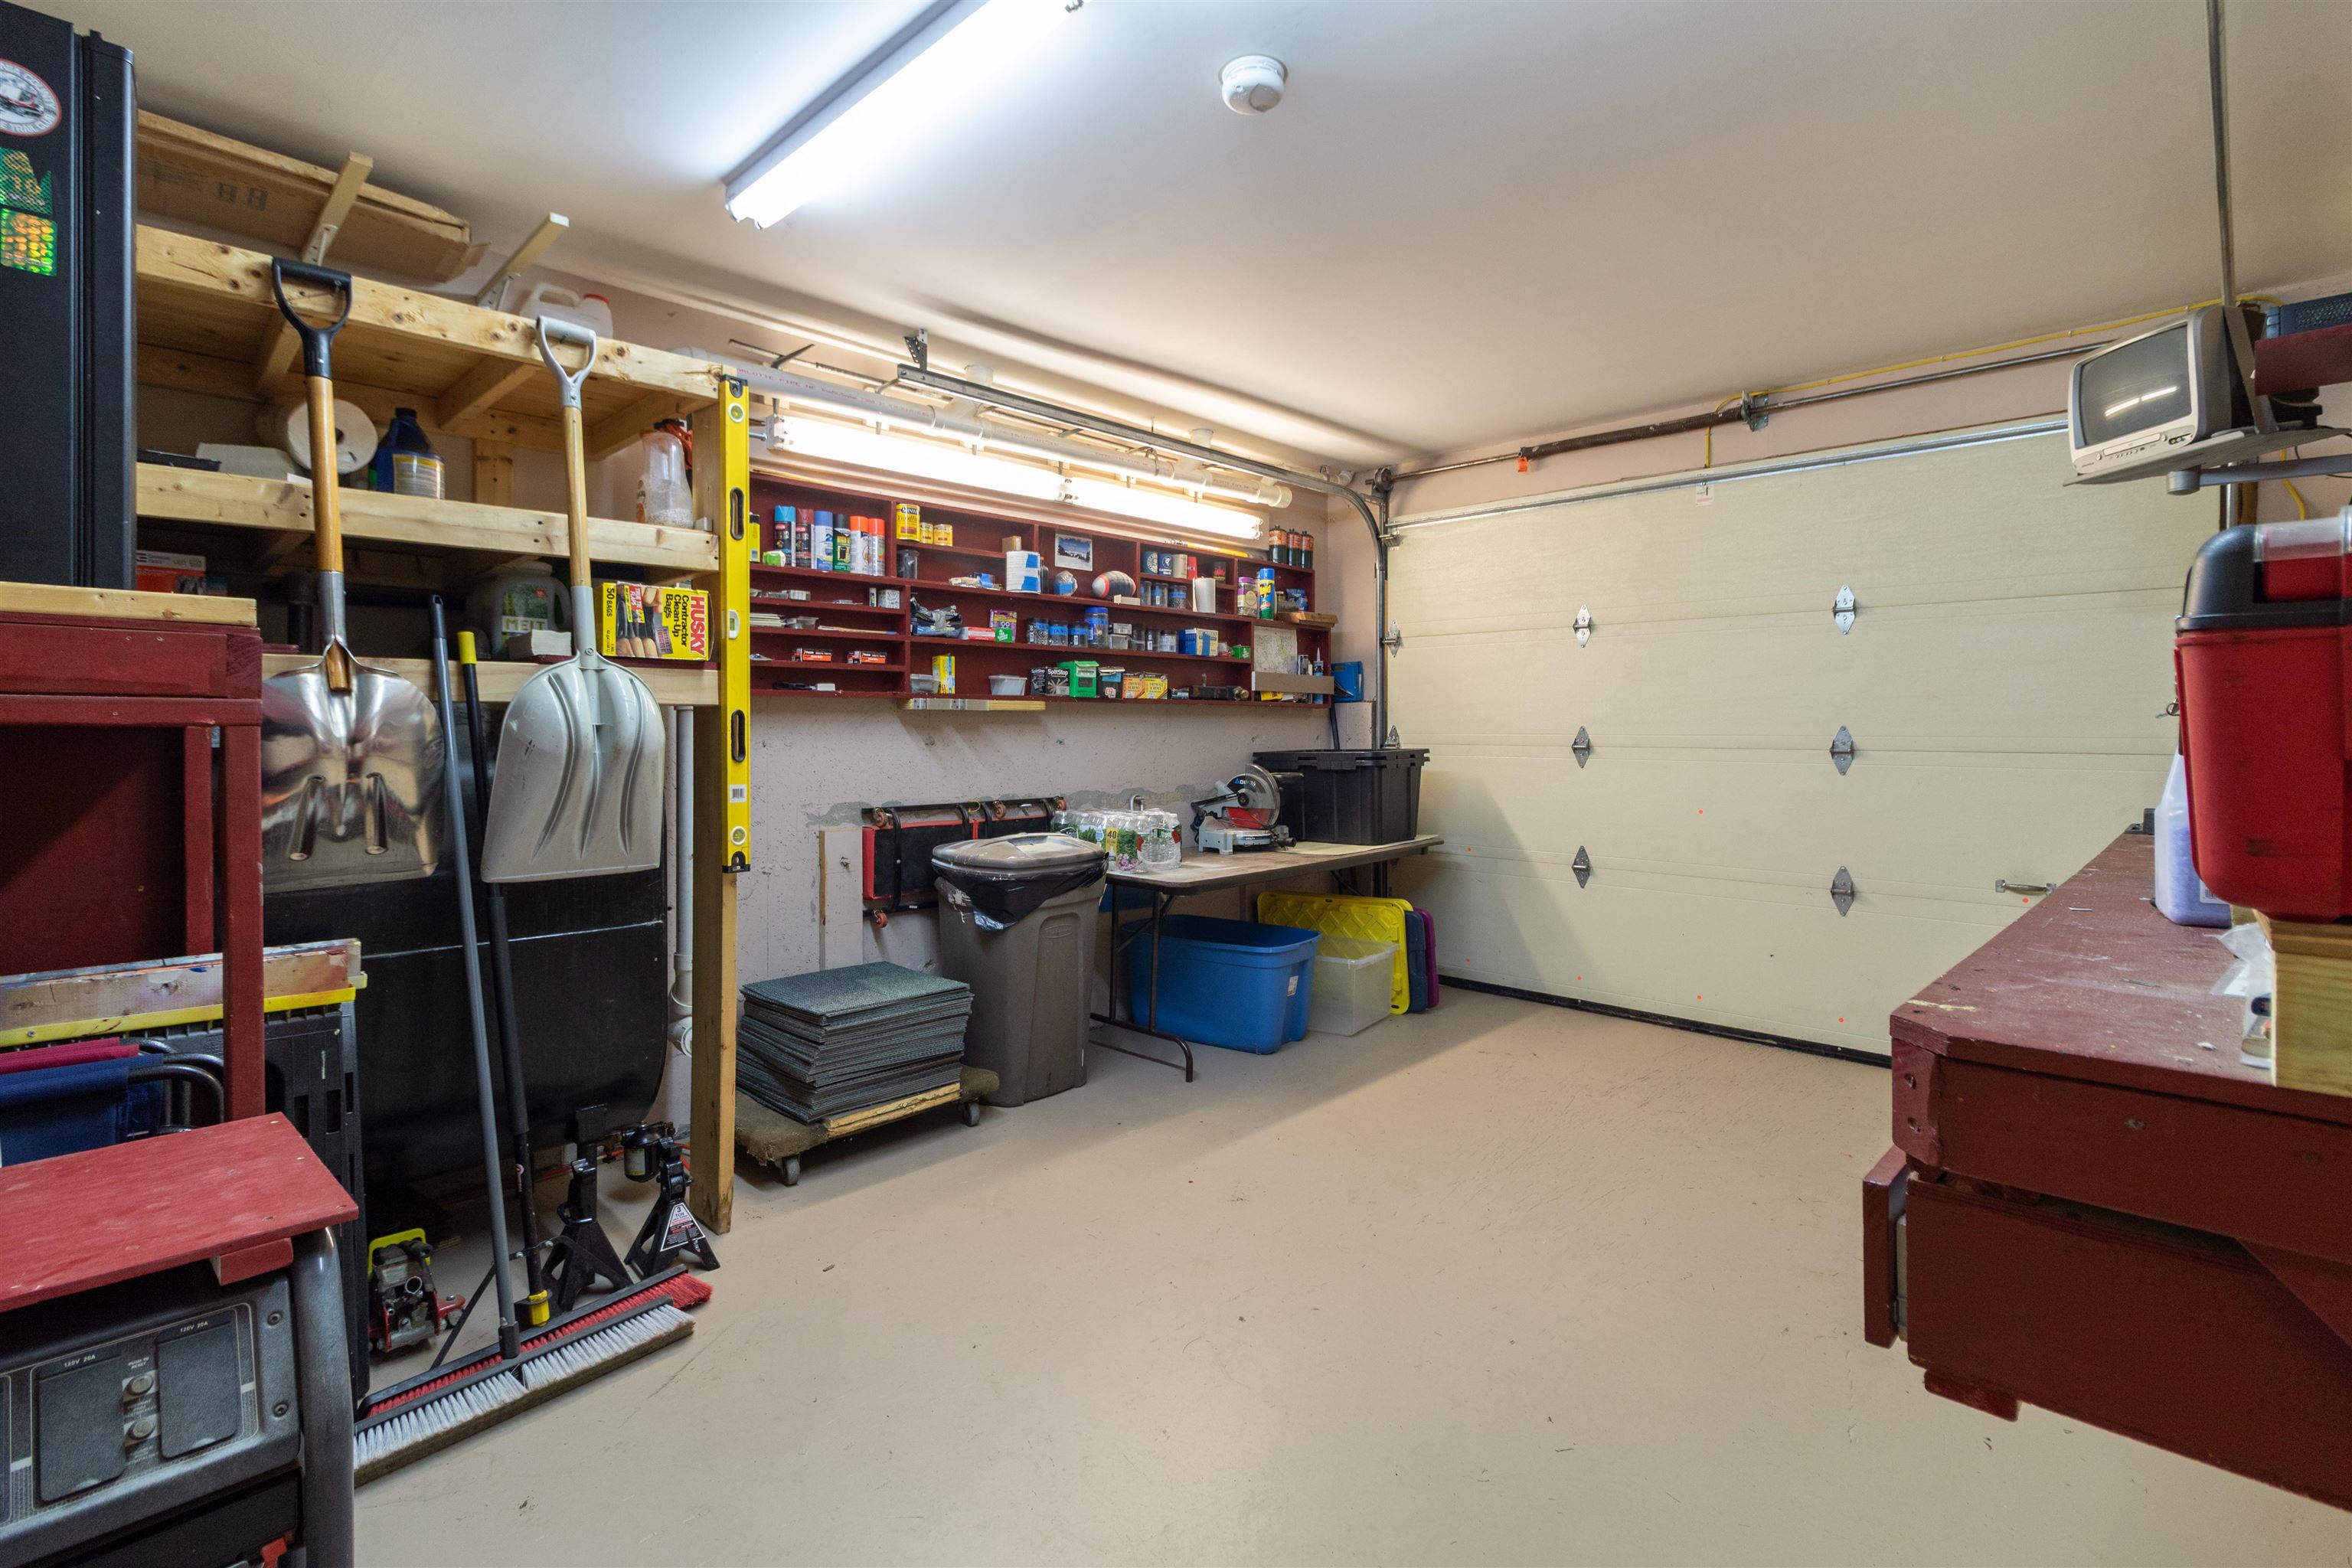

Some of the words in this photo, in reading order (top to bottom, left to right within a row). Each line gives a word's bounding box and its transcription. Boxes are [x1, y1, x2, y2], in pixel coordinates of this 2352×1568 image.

[606, 587, 616, 599] 50
[664, 594, 673, 619] Bags
[672, 594, 681, 637] Clean-Up
[681, 595, 690, 647] Contractor
[690, 595, 706, 657] HUSKY
[1107, 831, 1117, 839] 40
[64, 1358, 80, 1368] 120V
[83, 1354, 96, 1363] 20A
